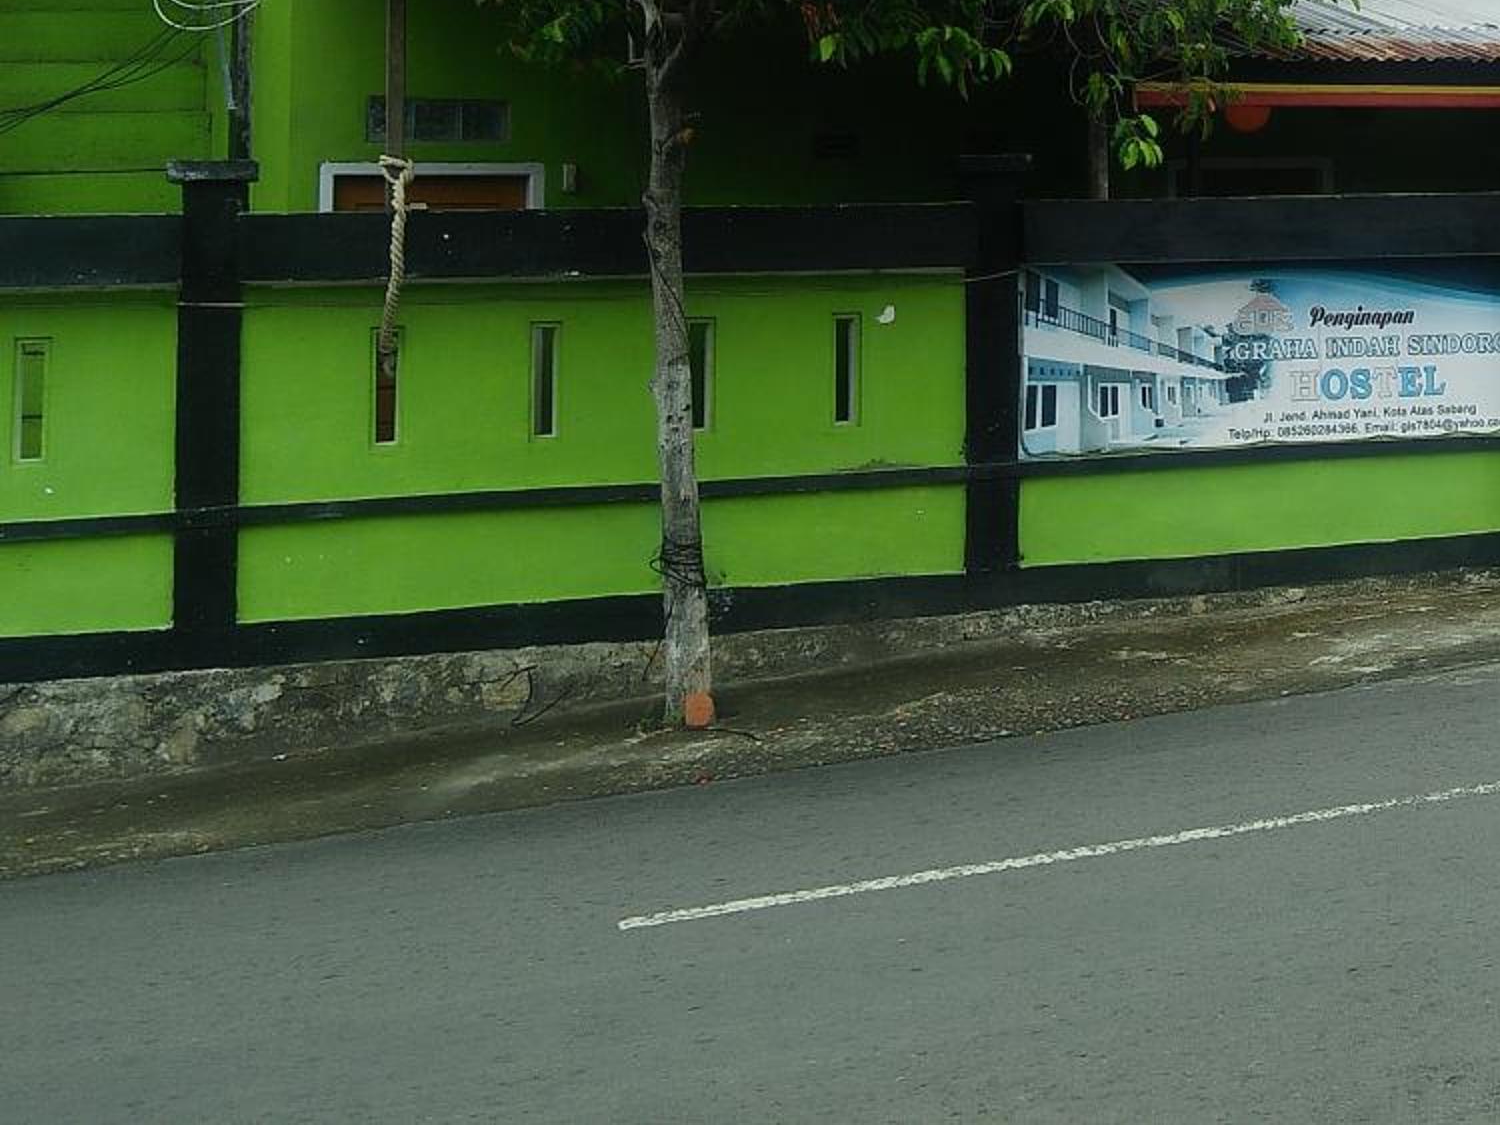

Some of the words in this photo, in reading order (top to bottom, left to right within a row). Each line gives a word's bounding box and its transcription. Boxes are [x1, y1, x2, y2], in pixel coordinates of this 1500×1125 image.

[1309, 305, 1415, 331] Penginapan
[1235, 337, 1318, 361] GRAHA
[1325, 334, 1401, 359] INDAH
[1288, 364, 1447, 402] HOSTEL
[1312, 408, 1351, 421] Ahmad
[1383, 406, 1407, 418] Kota
[1410, 405, 1433, 416] Atas
[1437, 404, 1477, 416] Sabang
